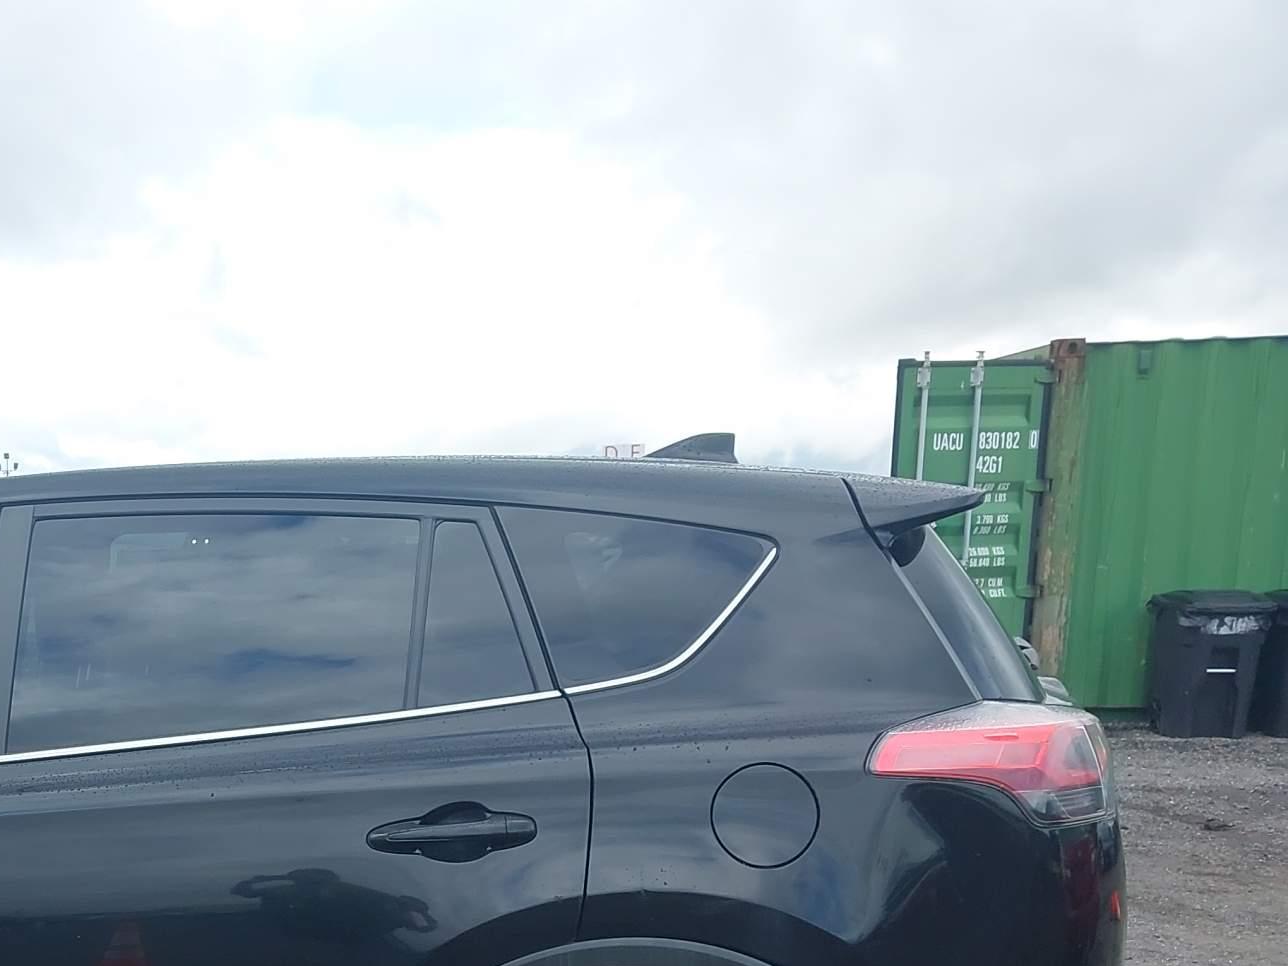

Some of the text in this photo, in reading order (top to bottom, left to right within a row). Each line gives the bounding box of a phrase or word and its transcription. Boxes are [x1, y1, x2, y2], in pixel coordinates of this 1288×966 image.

[933, 432, 964, 451] UACU
[978, 431, 1020, 450] 830182
[975, 455, 1003, 474] 42G1
